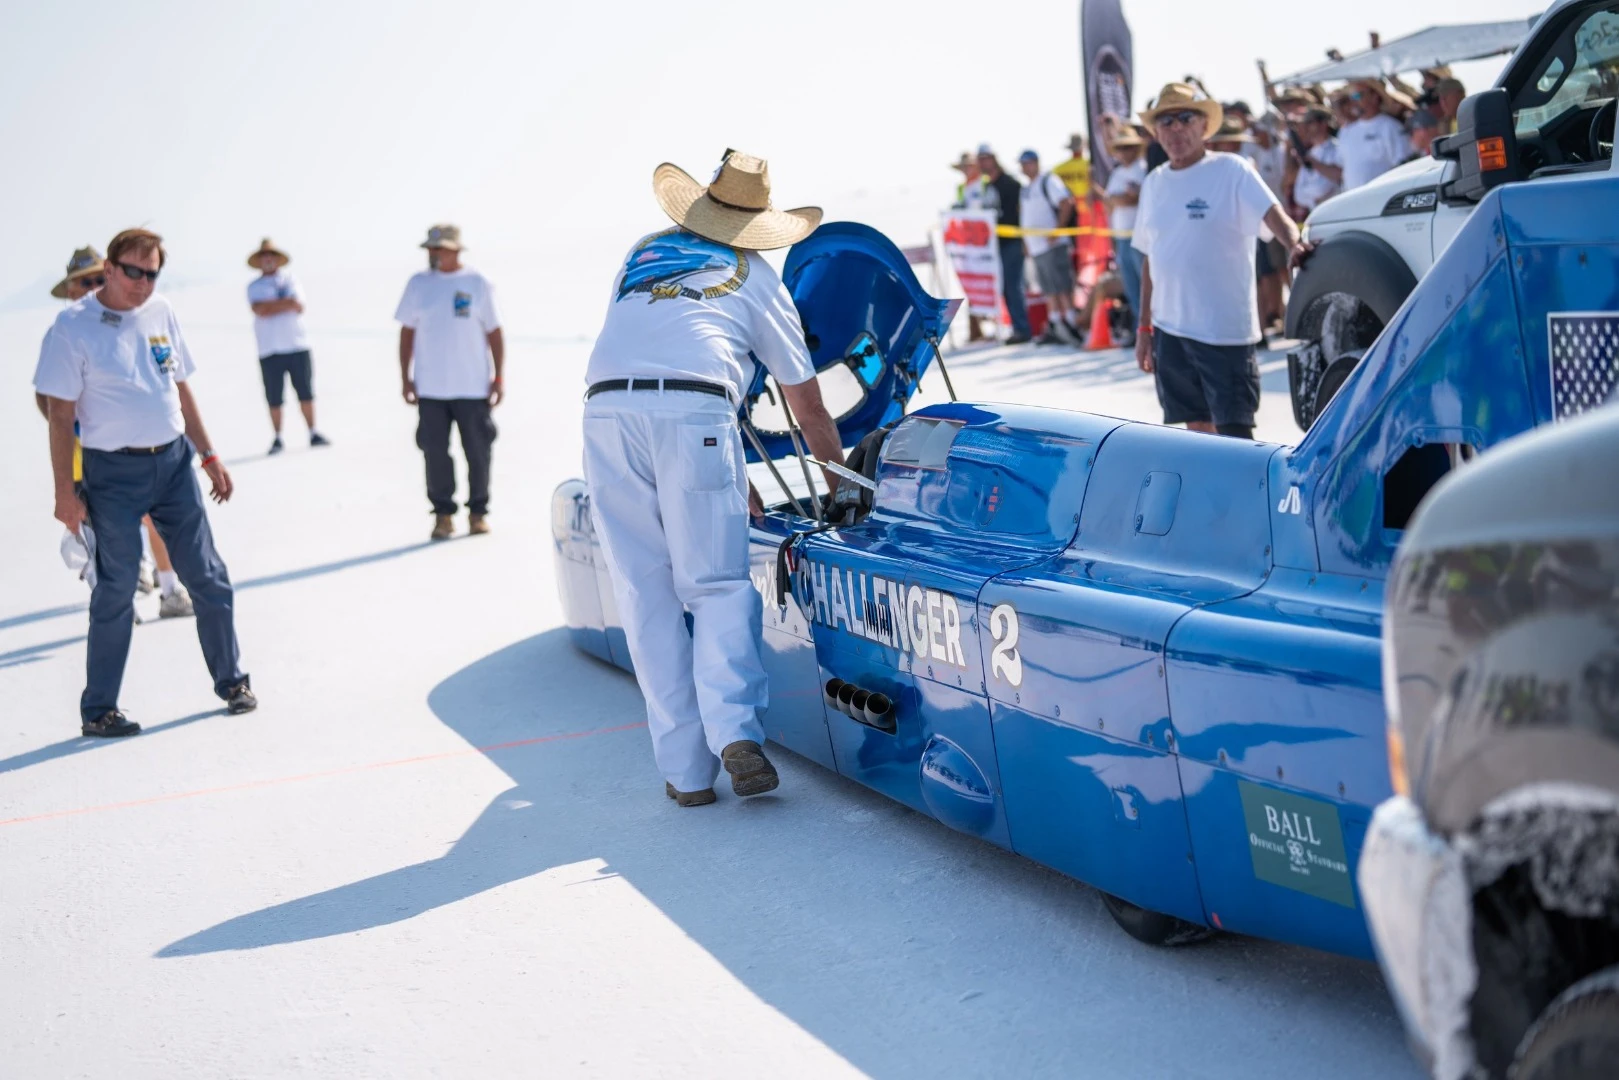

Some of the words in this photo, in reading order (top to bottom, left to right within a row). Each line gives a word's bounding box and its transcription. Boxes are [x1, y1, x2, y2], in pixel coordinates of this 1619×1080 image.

[652, 282, 682, 298] 50
[682, 287, 702, 301] 2018
[796, 557, 967, 668] CHALLENGER
[990, 603, 1023, 687] 2
[1264, 804, 1321, 846] BALL
